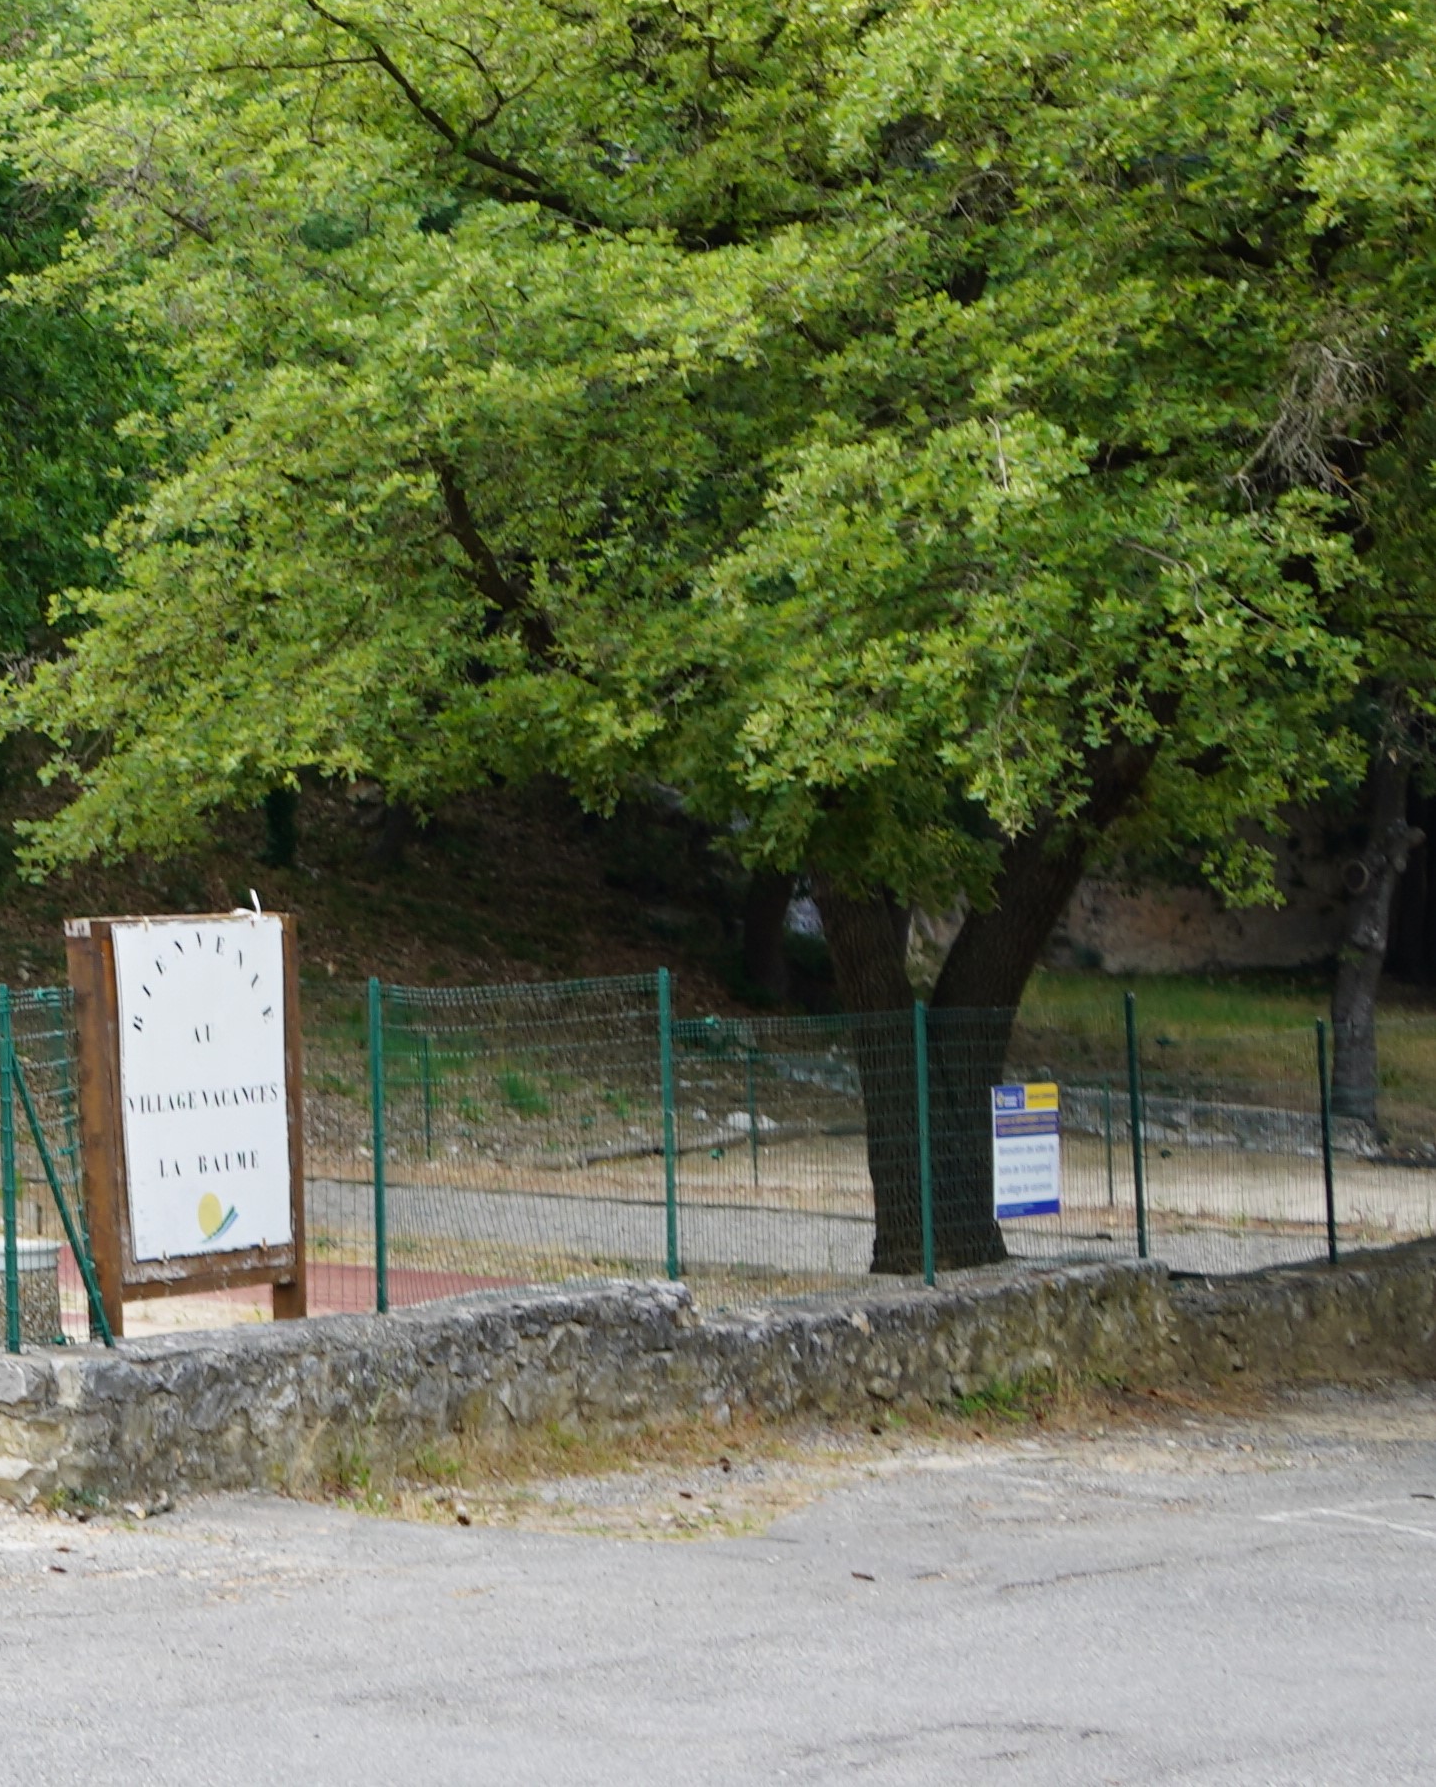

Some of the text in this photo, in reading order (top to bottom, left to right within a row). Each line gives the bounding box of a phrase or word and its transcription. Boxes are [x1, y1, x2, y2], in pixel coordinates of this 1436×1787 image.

[133, 931, 274, 1033] BIENVENUE
[193, 1024, 215, 1043] AU
[126, 1081, 278, 1114] VILLAGE VACANCES
[159, 1150, 260, 1178] LA BAUME
